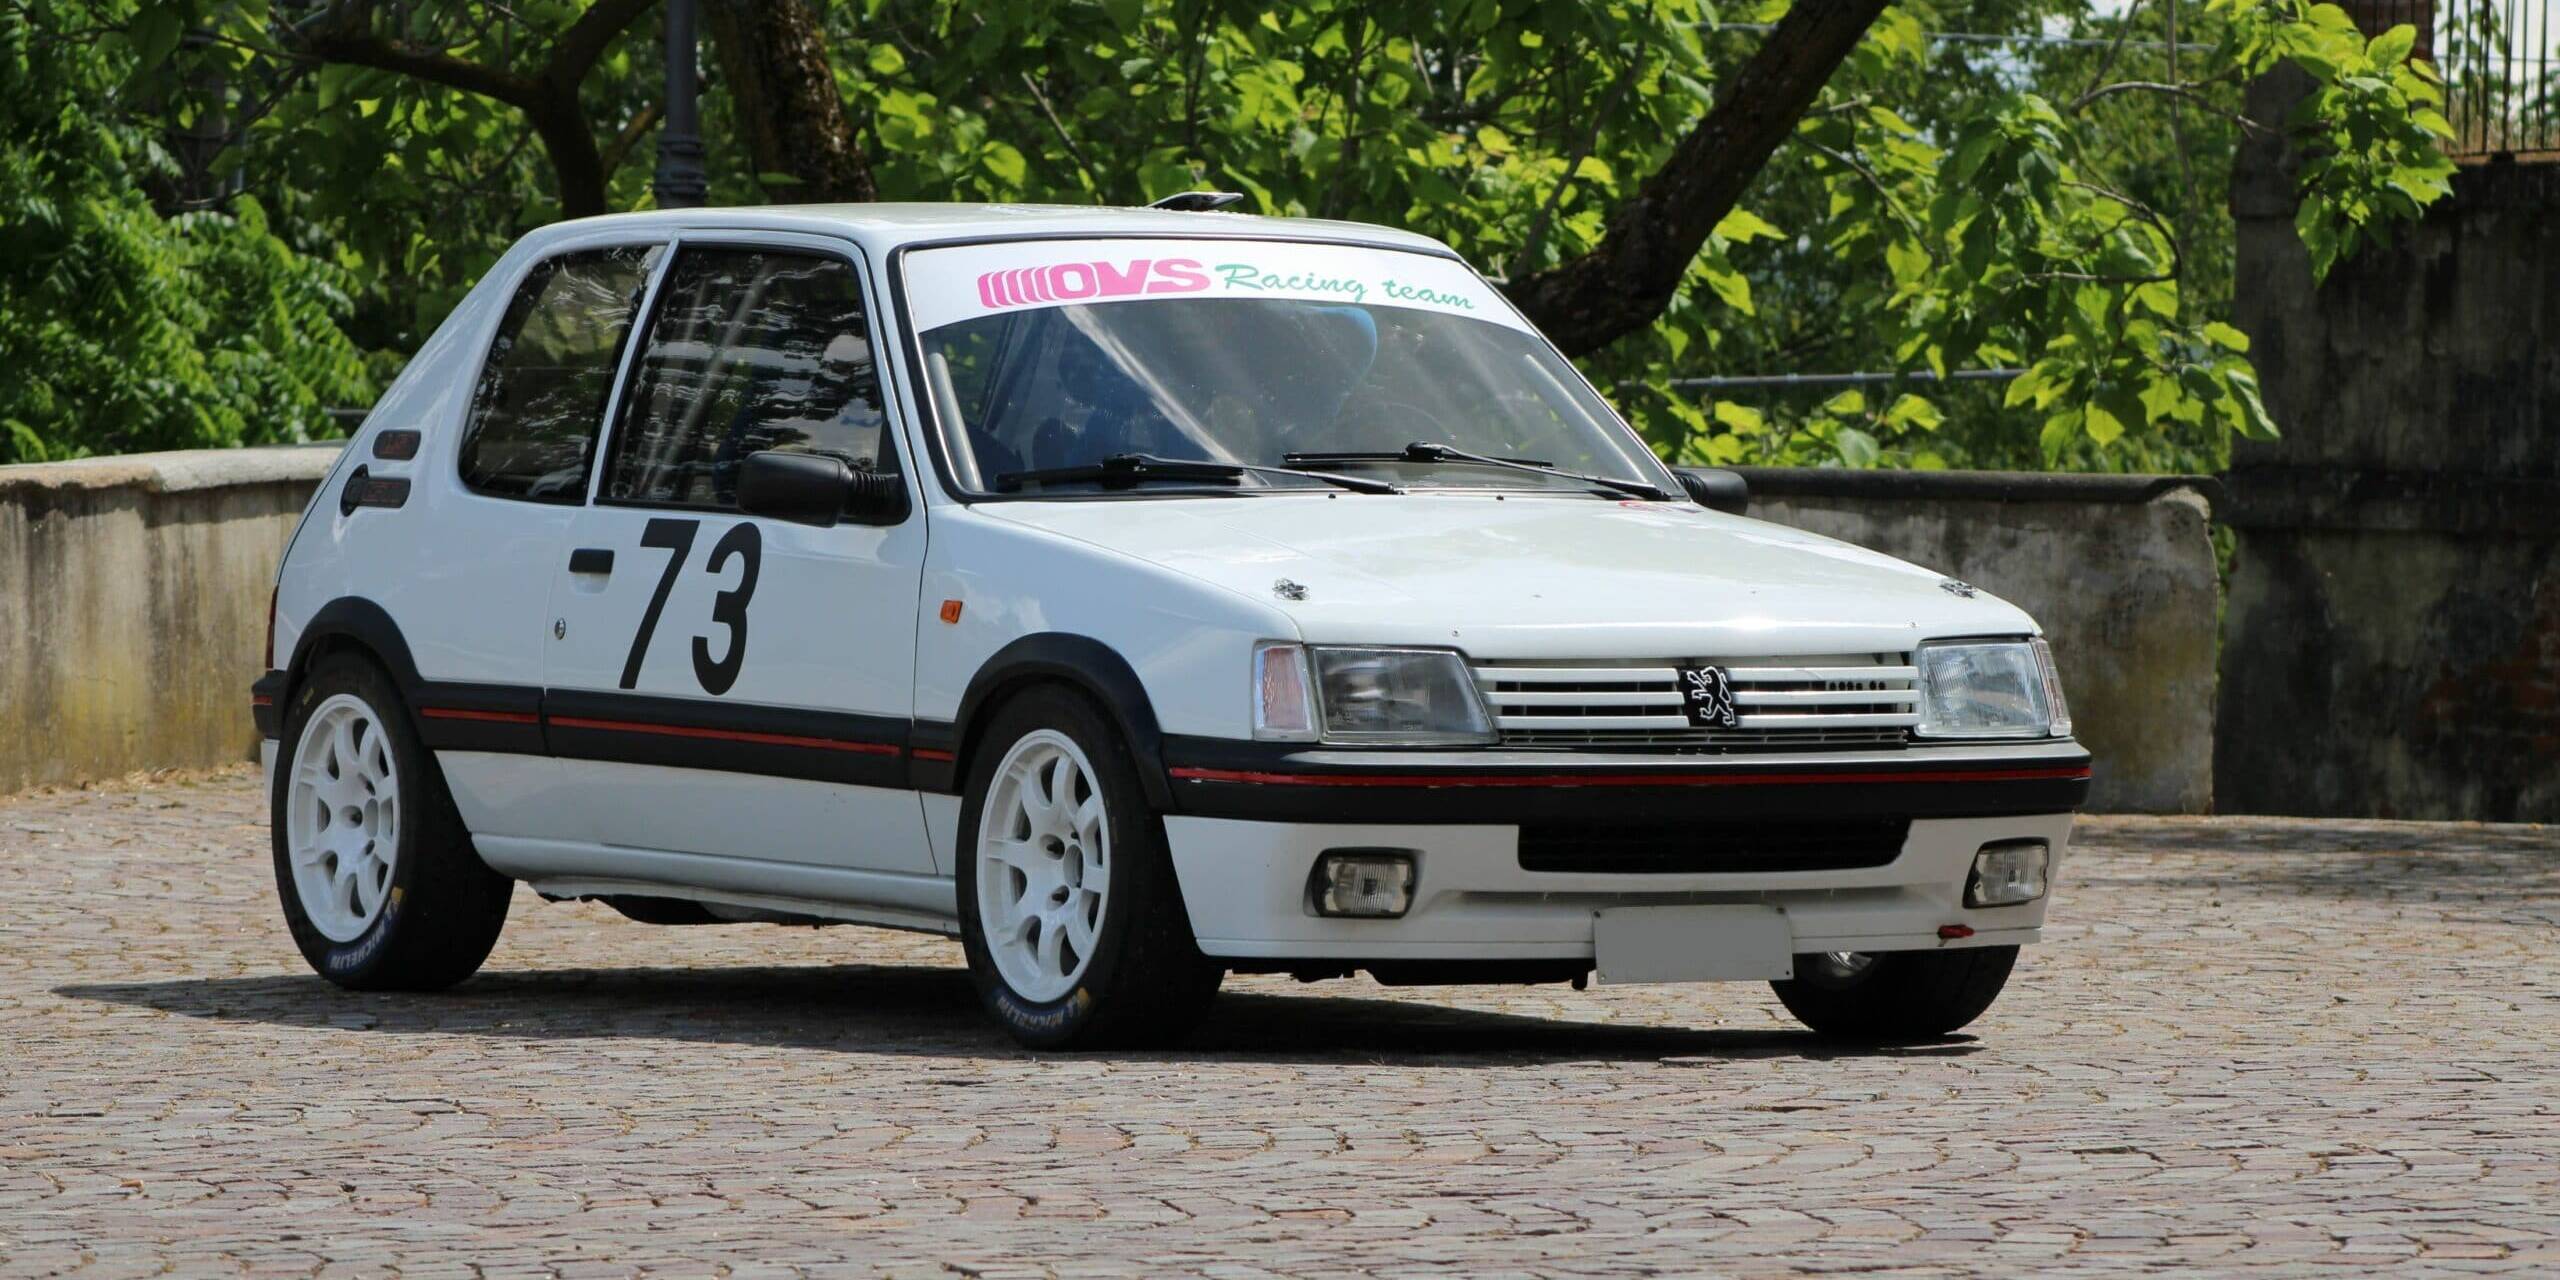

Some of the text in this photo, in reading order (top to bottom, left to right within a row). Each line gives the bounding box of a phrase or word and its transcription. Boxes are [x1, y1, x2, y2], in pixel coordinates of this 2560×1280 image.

[1042, 258, 1475, 310] OVS Racing team
[619, 517, 762, 696] 73
